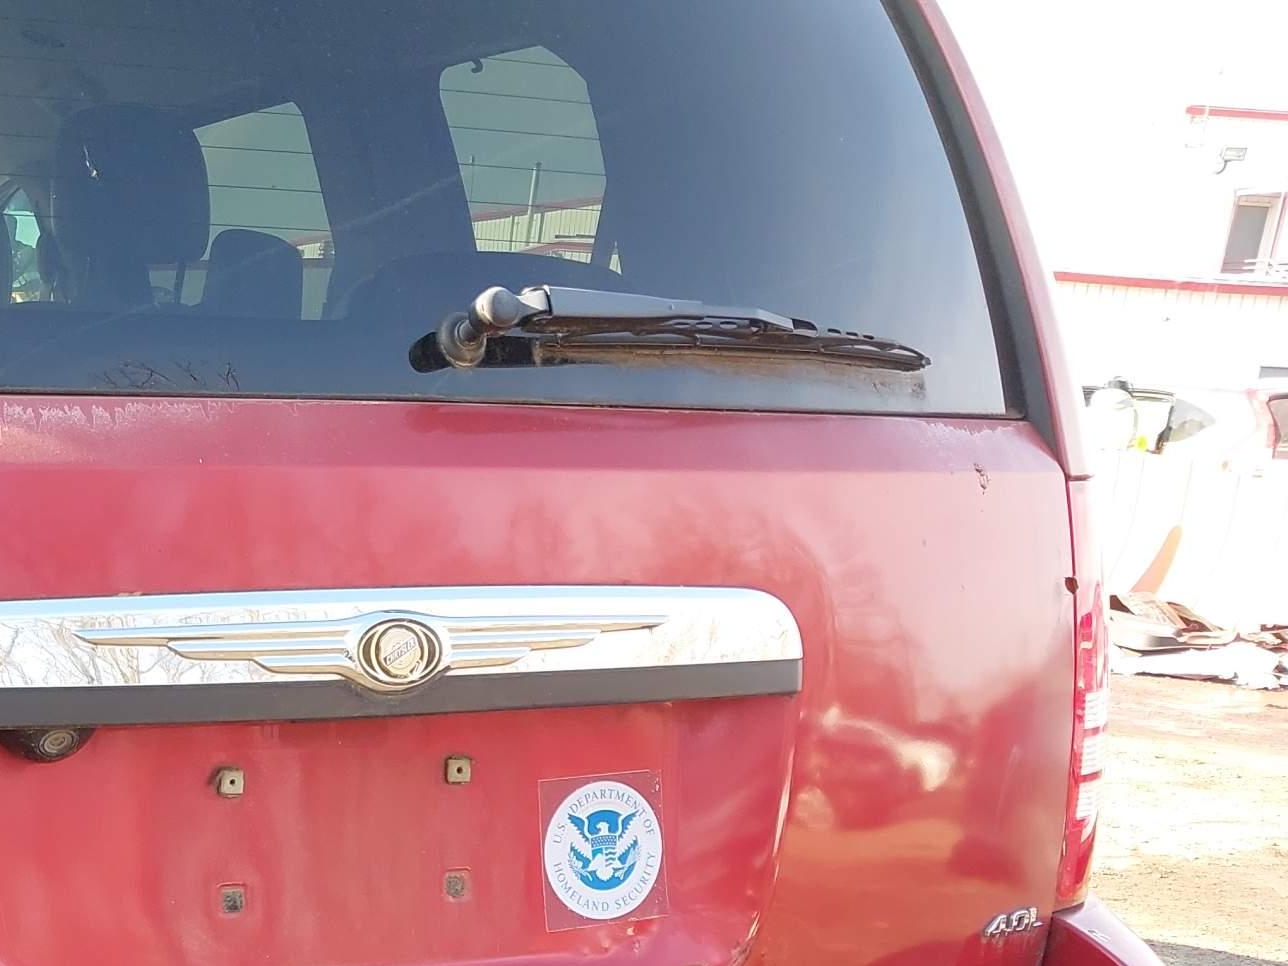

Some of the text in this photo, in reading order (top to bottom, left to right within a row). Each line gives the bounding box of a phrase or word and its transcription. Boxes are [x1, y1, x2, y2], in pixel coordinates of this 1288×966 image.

[553, 788, 655, 844] U.S. DEPARTMENT OF
[553, 853, 656, 912] HOMELAND SECURITY
